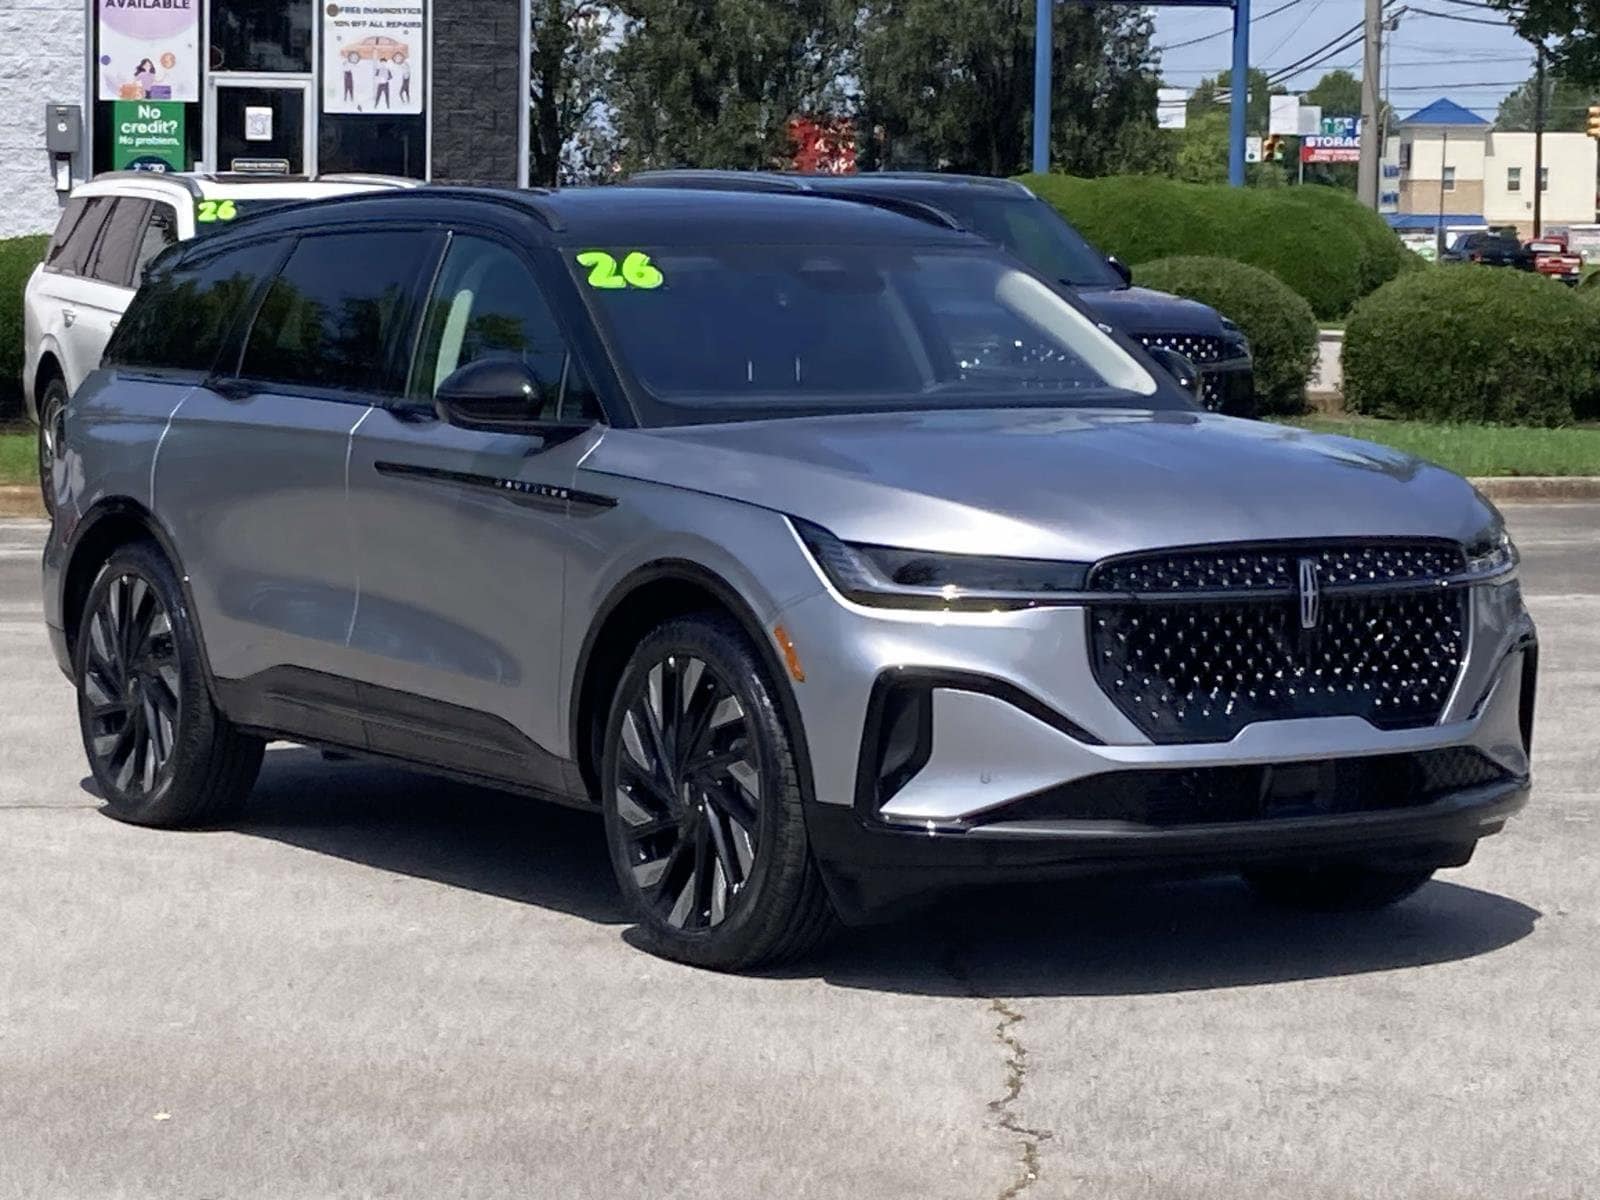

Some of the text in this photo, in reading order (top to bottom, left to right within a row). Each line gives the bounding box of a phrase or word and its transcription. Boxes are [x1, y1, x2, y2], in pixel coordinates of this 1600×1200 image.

[105, 0, 191, 9] AVAILABLE
[363, 7, 422, 15] DIAGNOSTICS
[386, 20, 422, 28] REPAIRS
[138, 105, 161, 119] No
[121, 120, 178, 135] credit?
[118, 136, 180, 147] No problem.
[198, 200, 237, 222] 26
[576, 251, 664, 289] 26
